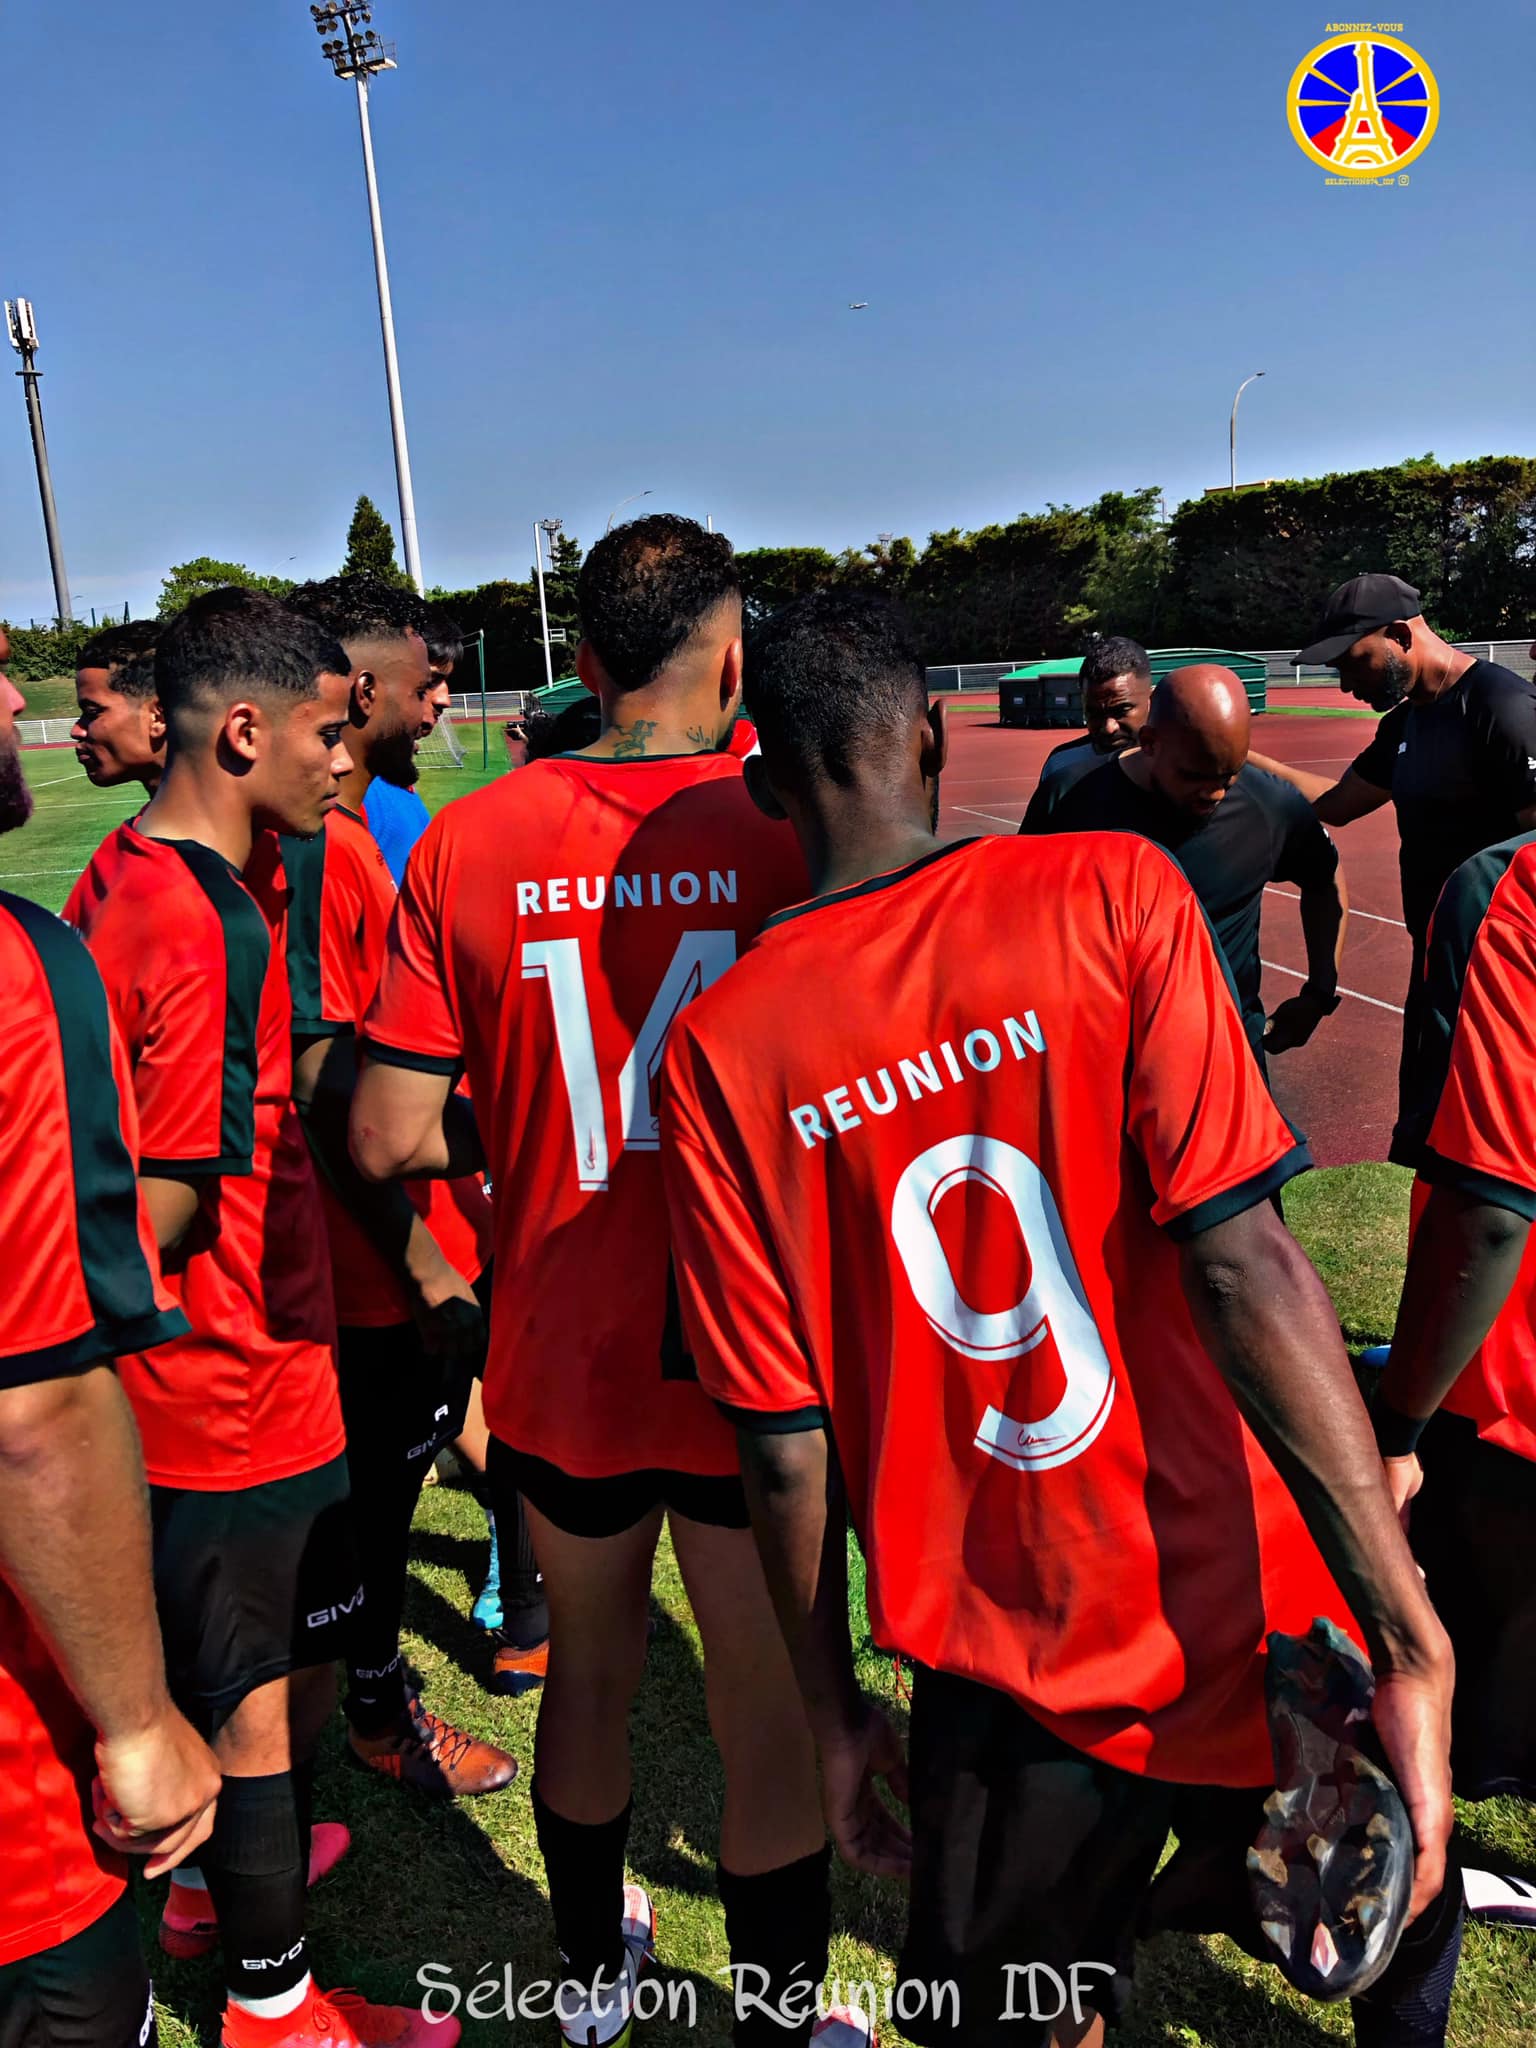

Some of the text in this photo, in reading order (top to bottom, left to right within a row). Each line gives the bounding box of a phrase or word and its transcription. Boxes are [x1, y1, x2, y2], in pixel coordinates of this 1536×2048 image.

[516, 870, 738, 916] REUNION
[789, 1009, 1048, 1150] REUNION
[891, 1134, 1117, 1472] 9
